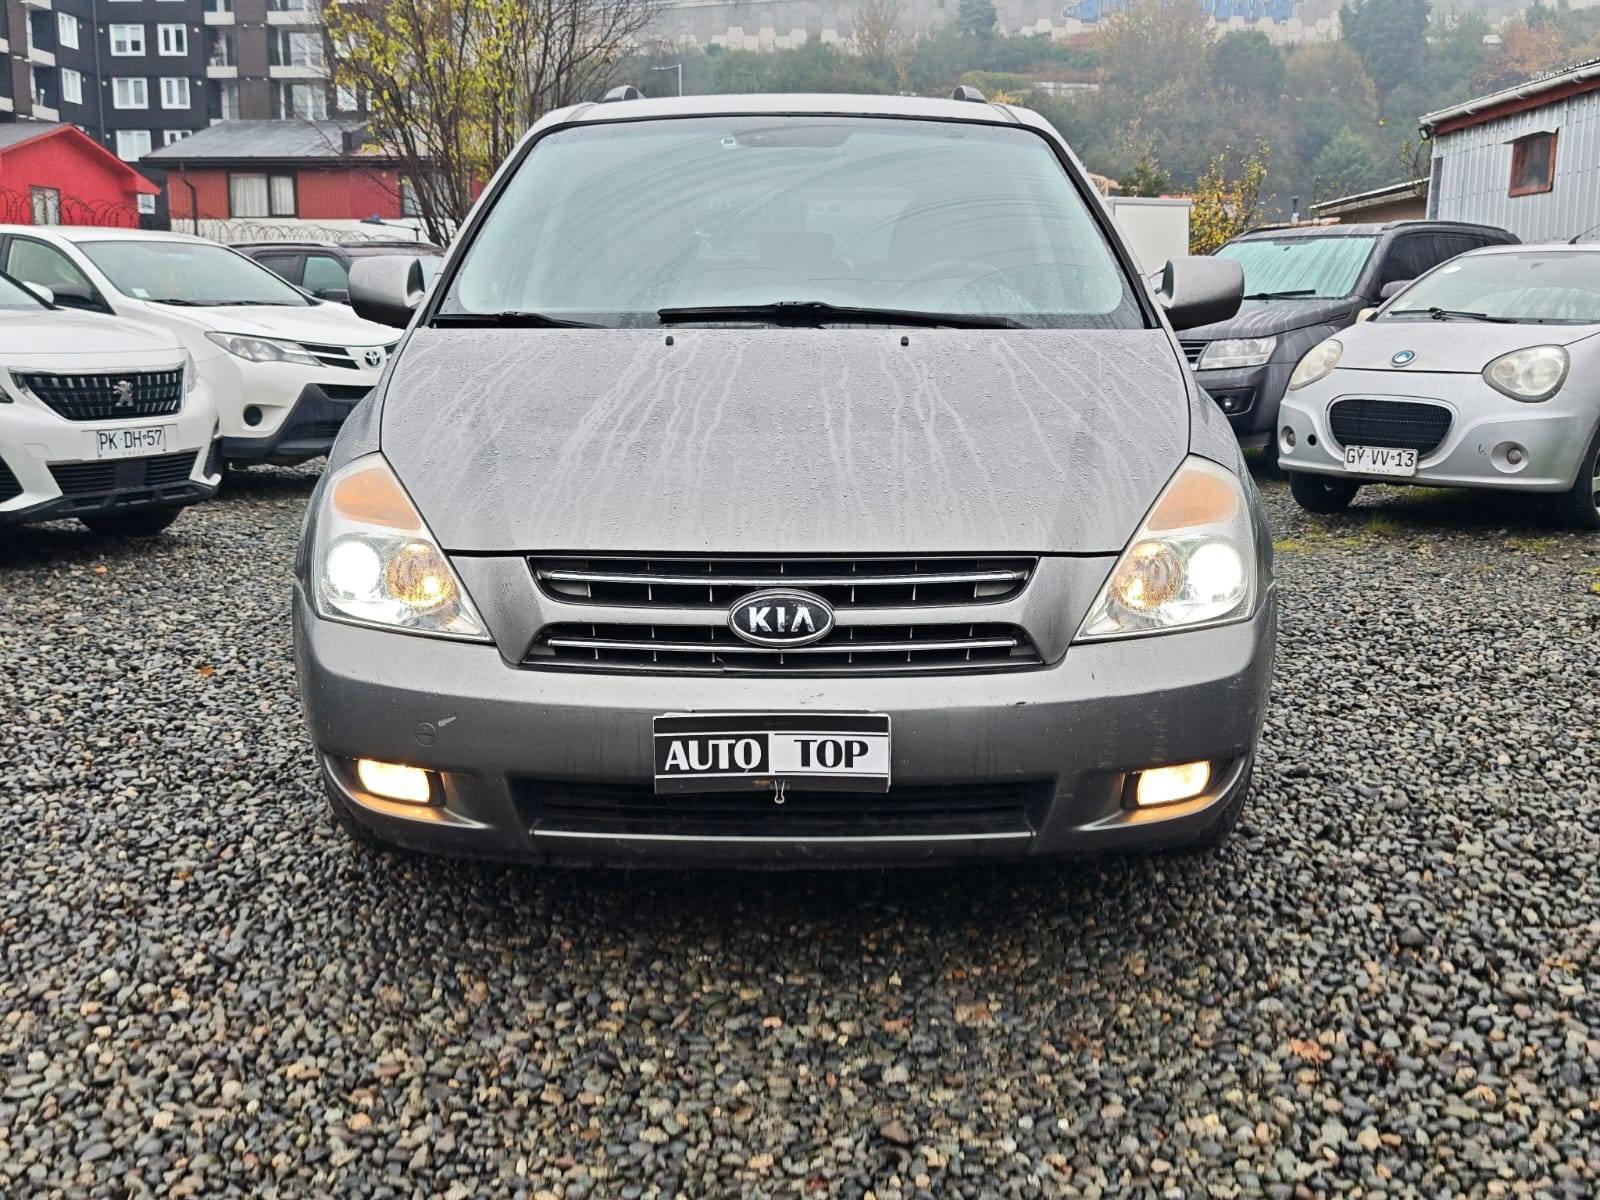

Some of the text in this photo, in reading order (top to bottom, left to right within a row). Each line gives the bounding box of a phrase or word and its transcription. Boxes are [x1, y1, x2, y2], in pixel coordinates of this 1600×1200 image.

[748, 606, 816, 632] KIA
[664, 738, 869, 771] AUTO TOP
